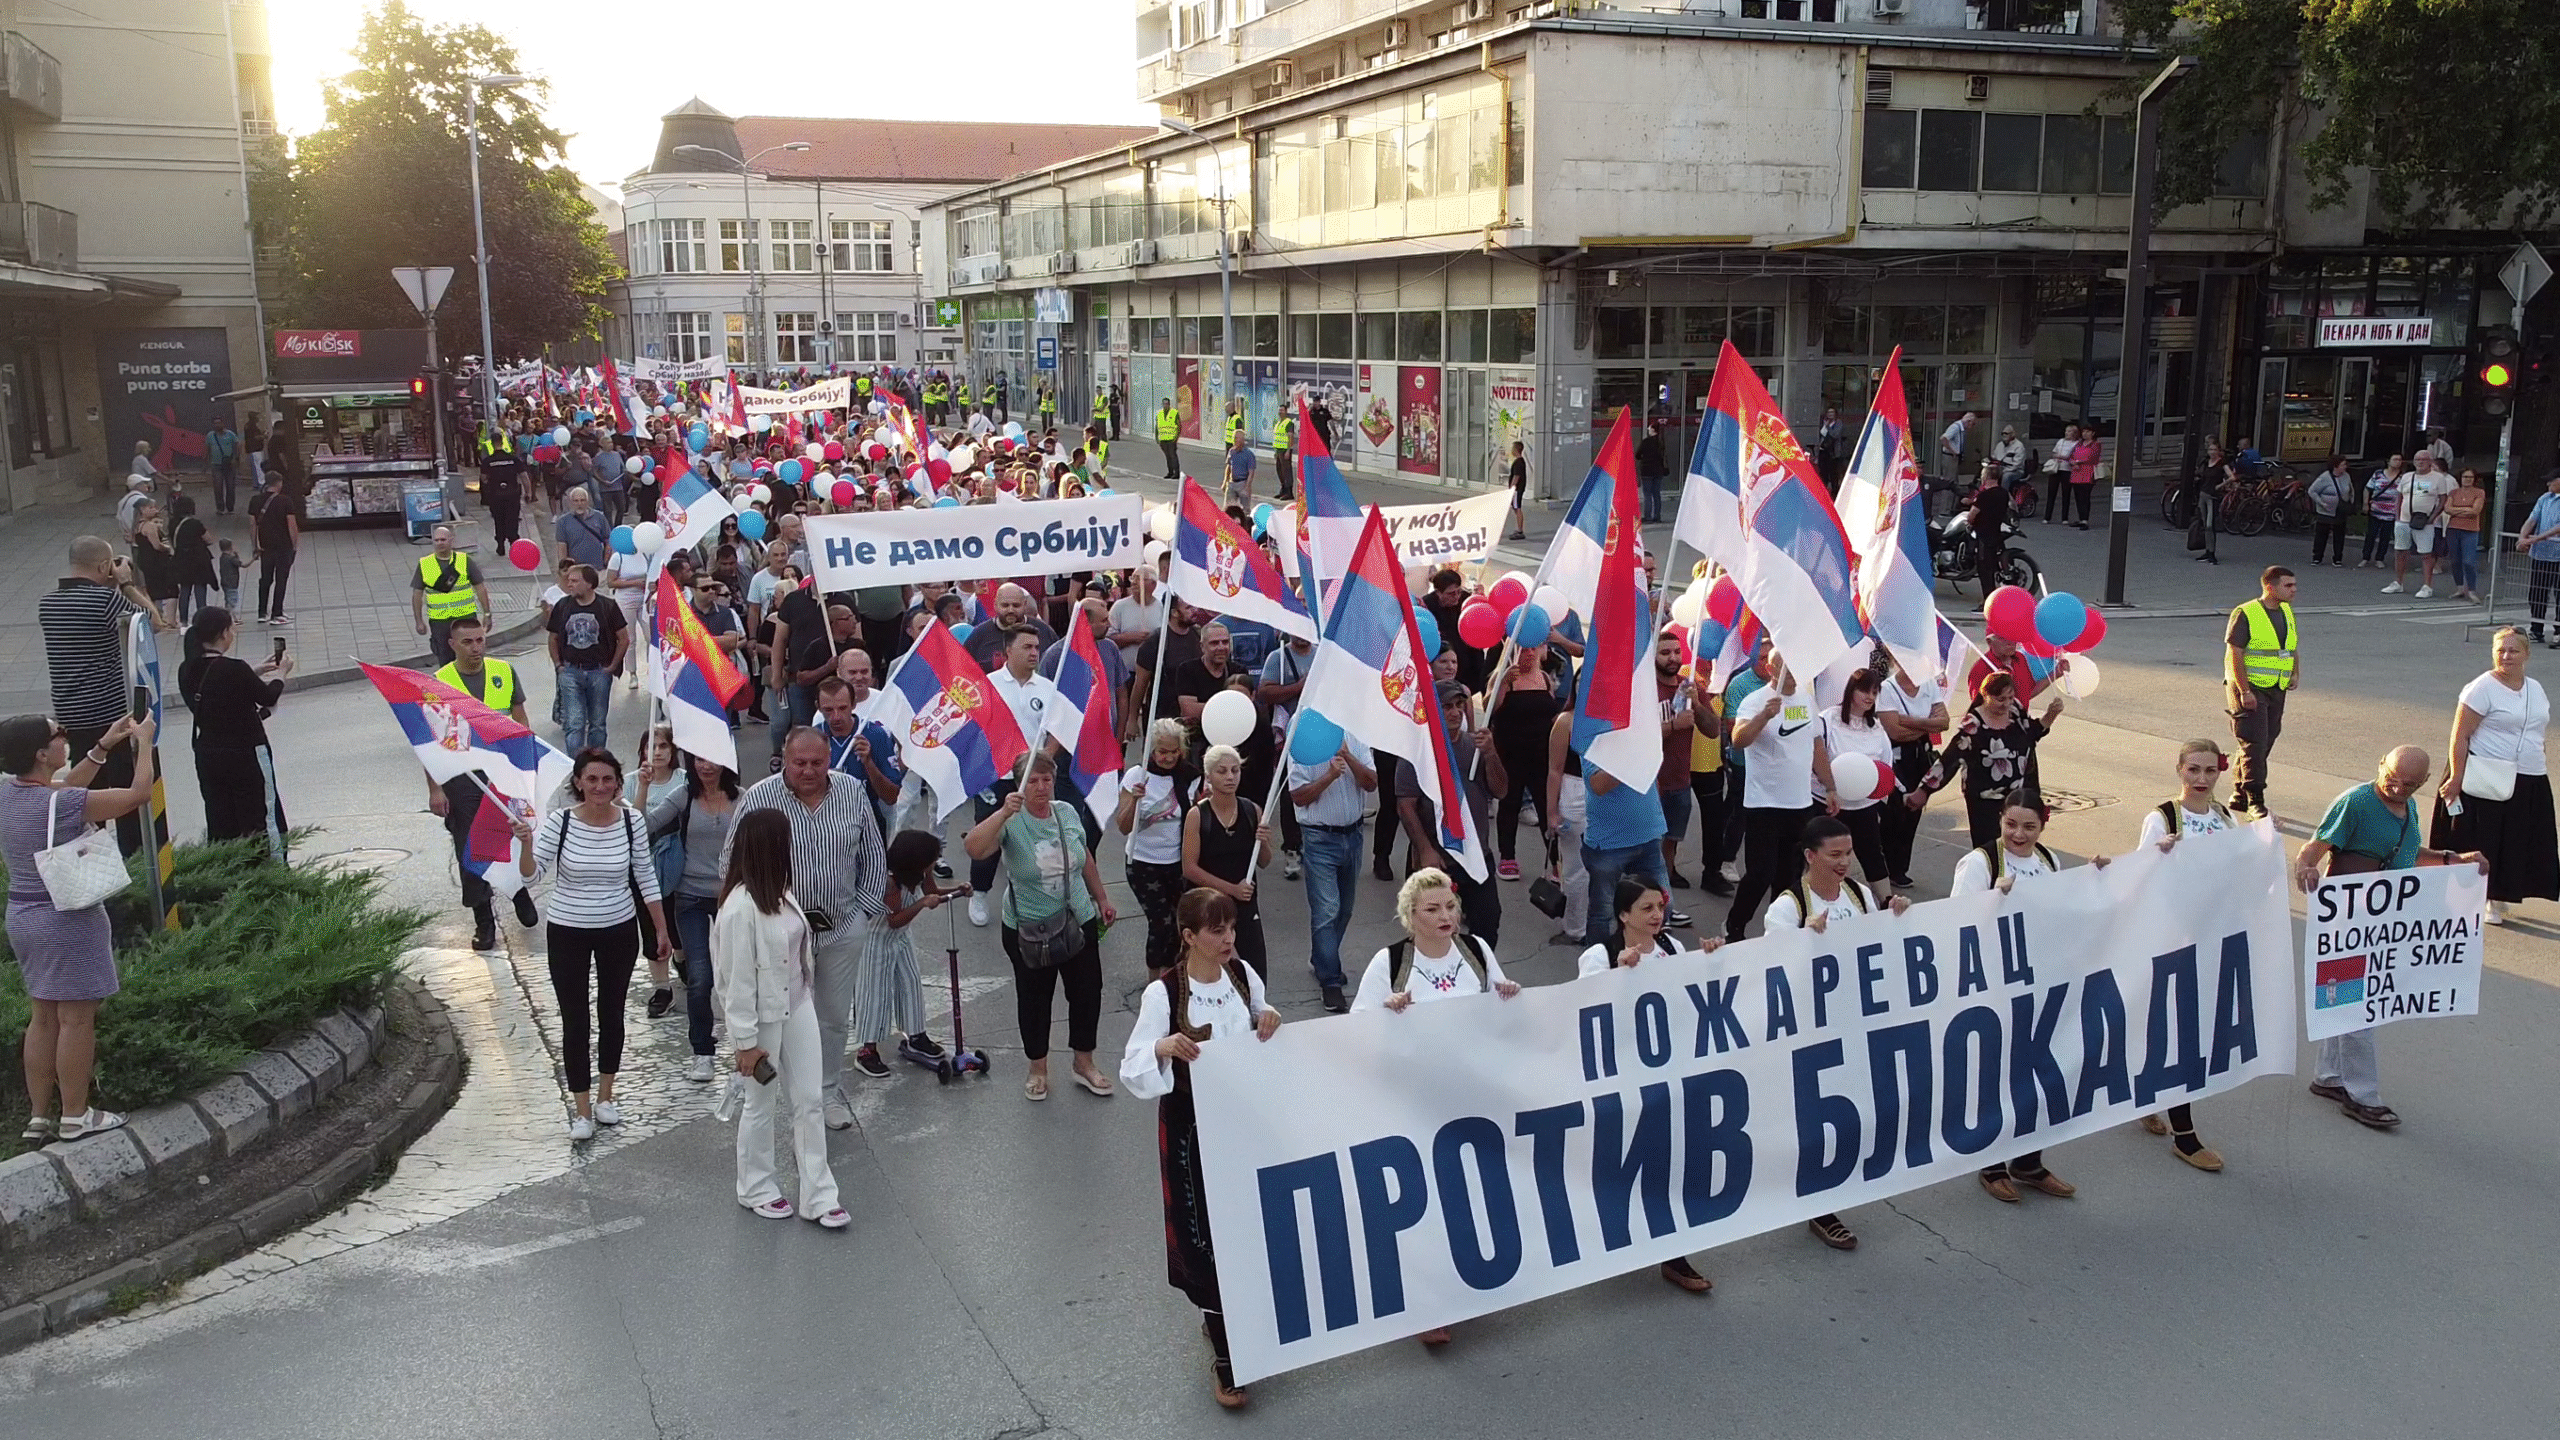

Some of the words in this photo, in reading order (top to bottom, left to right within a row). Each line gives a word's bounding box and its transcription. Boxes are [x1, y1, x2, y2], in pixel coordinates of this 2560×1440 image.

[139, 341, 185, 350] KENGUR
[282, 335, 307, 354] Moj
[2323, 324, 2367, 341] ПЕКАРА
[2371, 324, 2392, 340] НОЋ
[2396, 323, 2404, 340] И
[2406, 323, 2430, 342] ДАН
[118, 361, 161, 375] Puna
[164, 361, 211, 374] torba
[127, 380, 168, 394] puno
[172, 379, 206, 390] srce
[1491, 386, 1535, 401] NOVITET
[743, 396, 784, 406] дамо
[1408, 506, 1461, 532] моју
[825, 536, 876, 569] Не
[888, 535, 984, 567] дамо
[994, 515, 1129, 563] Србију!
[1409, 527, 1486, 557] назад!
[2317, 875, 2421, 922] STOP
[2368, 947, 2397, 973] NE
[2410, 942, 2466, 967] SME
[1579, 912, 2035, 1082] ПОЖАРЕВАЦ
[2367, 972, 2395, 998] DA
[1256, 1068, 1755, 1346] ПРОТИВ
[1794, 930, 2259, 1198] БЛОКАДА
